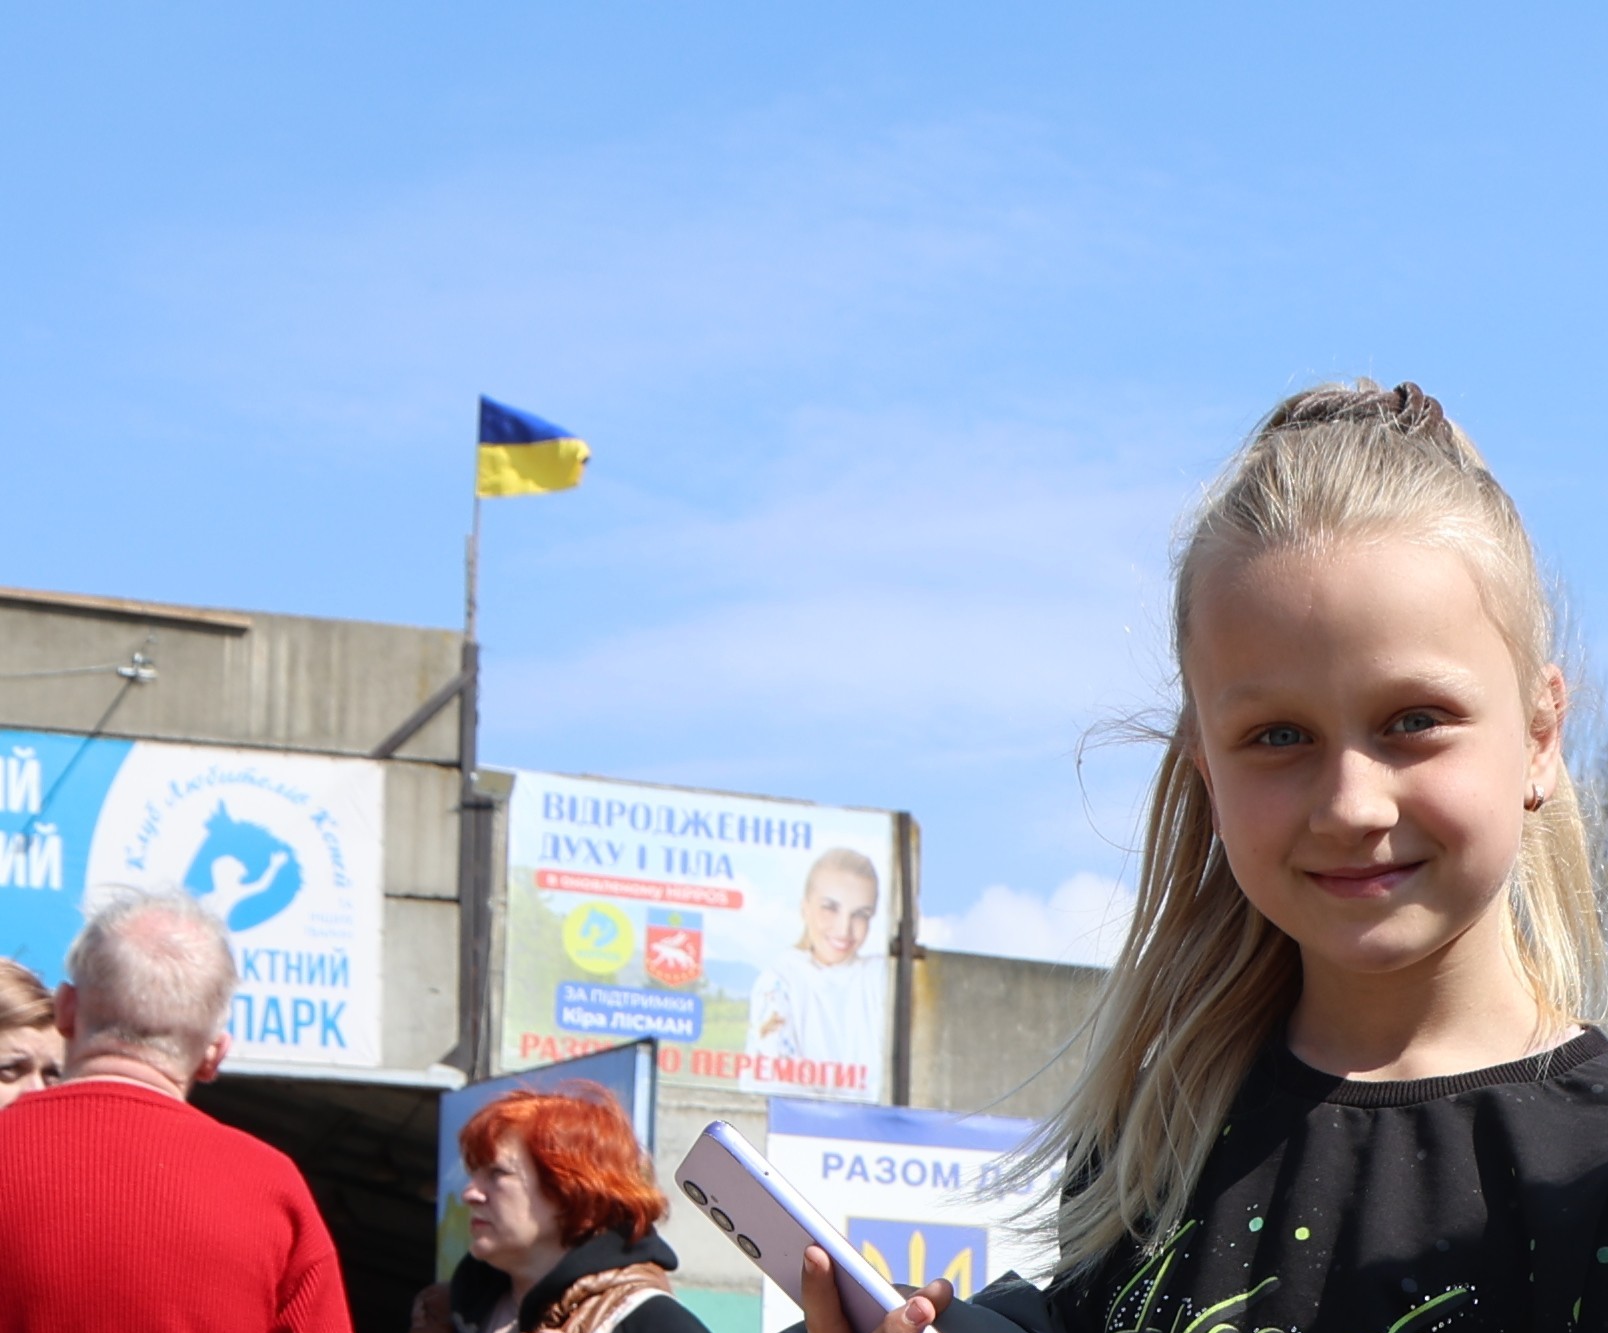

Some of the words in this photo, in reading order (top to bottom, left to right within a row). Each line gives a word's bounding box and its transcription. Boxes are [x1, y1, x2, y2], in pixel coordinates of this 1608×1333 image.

[542, 791, 813, 850] ВІДРОДЖЕННЯ
[538, 832, 626, 867] ДУХУ
[637, 843, 647, 871] І
[663, 846, 735, 880] ТІЛА
[240, 945, 350, 989] КТНИЙ
[563, 985, 588, 1003] ЗА
[562, 1007, 608, 1030] Кіра
[611, 1012, 694, 1035] ЛІСМАН
[520, 1032, 620, 1062] РАЗО
[690, 1050, 868, 1090] ПЕРЕМОГИ!
[822, 1152, 960, 1190] РАЗОМ
